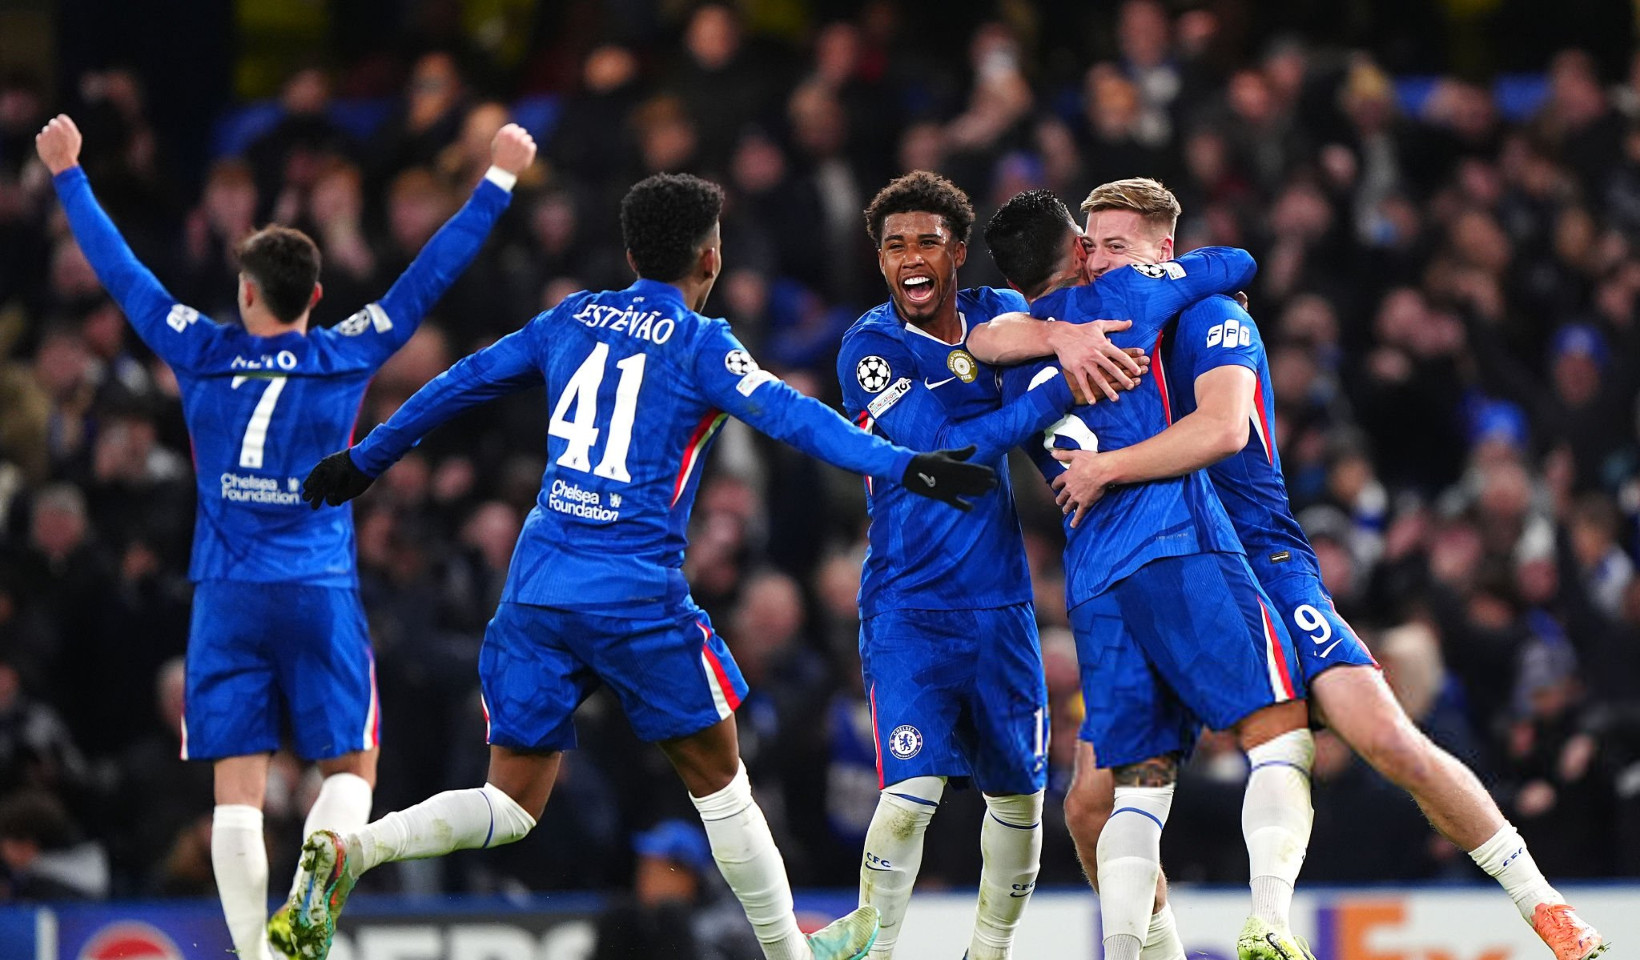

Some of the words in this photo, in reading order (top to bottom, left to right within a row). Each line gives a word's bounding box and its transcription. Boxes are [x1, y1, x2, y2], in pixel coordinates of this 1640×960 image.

[573, 304, 675, 345] ESTÊVÃO
[231, 374, 287, 469] 7
[548, 341, 647, 484] 41
[221, 472, 277, 489] Chelsea
[552, 479, 599, 505] Chelsea
[222, 485, 300, 504] Foundation
[549, 495, 619, 522] Foundation
[1294, 604, 1332, 645] 9
[866, 852, 891, 868] CFC
